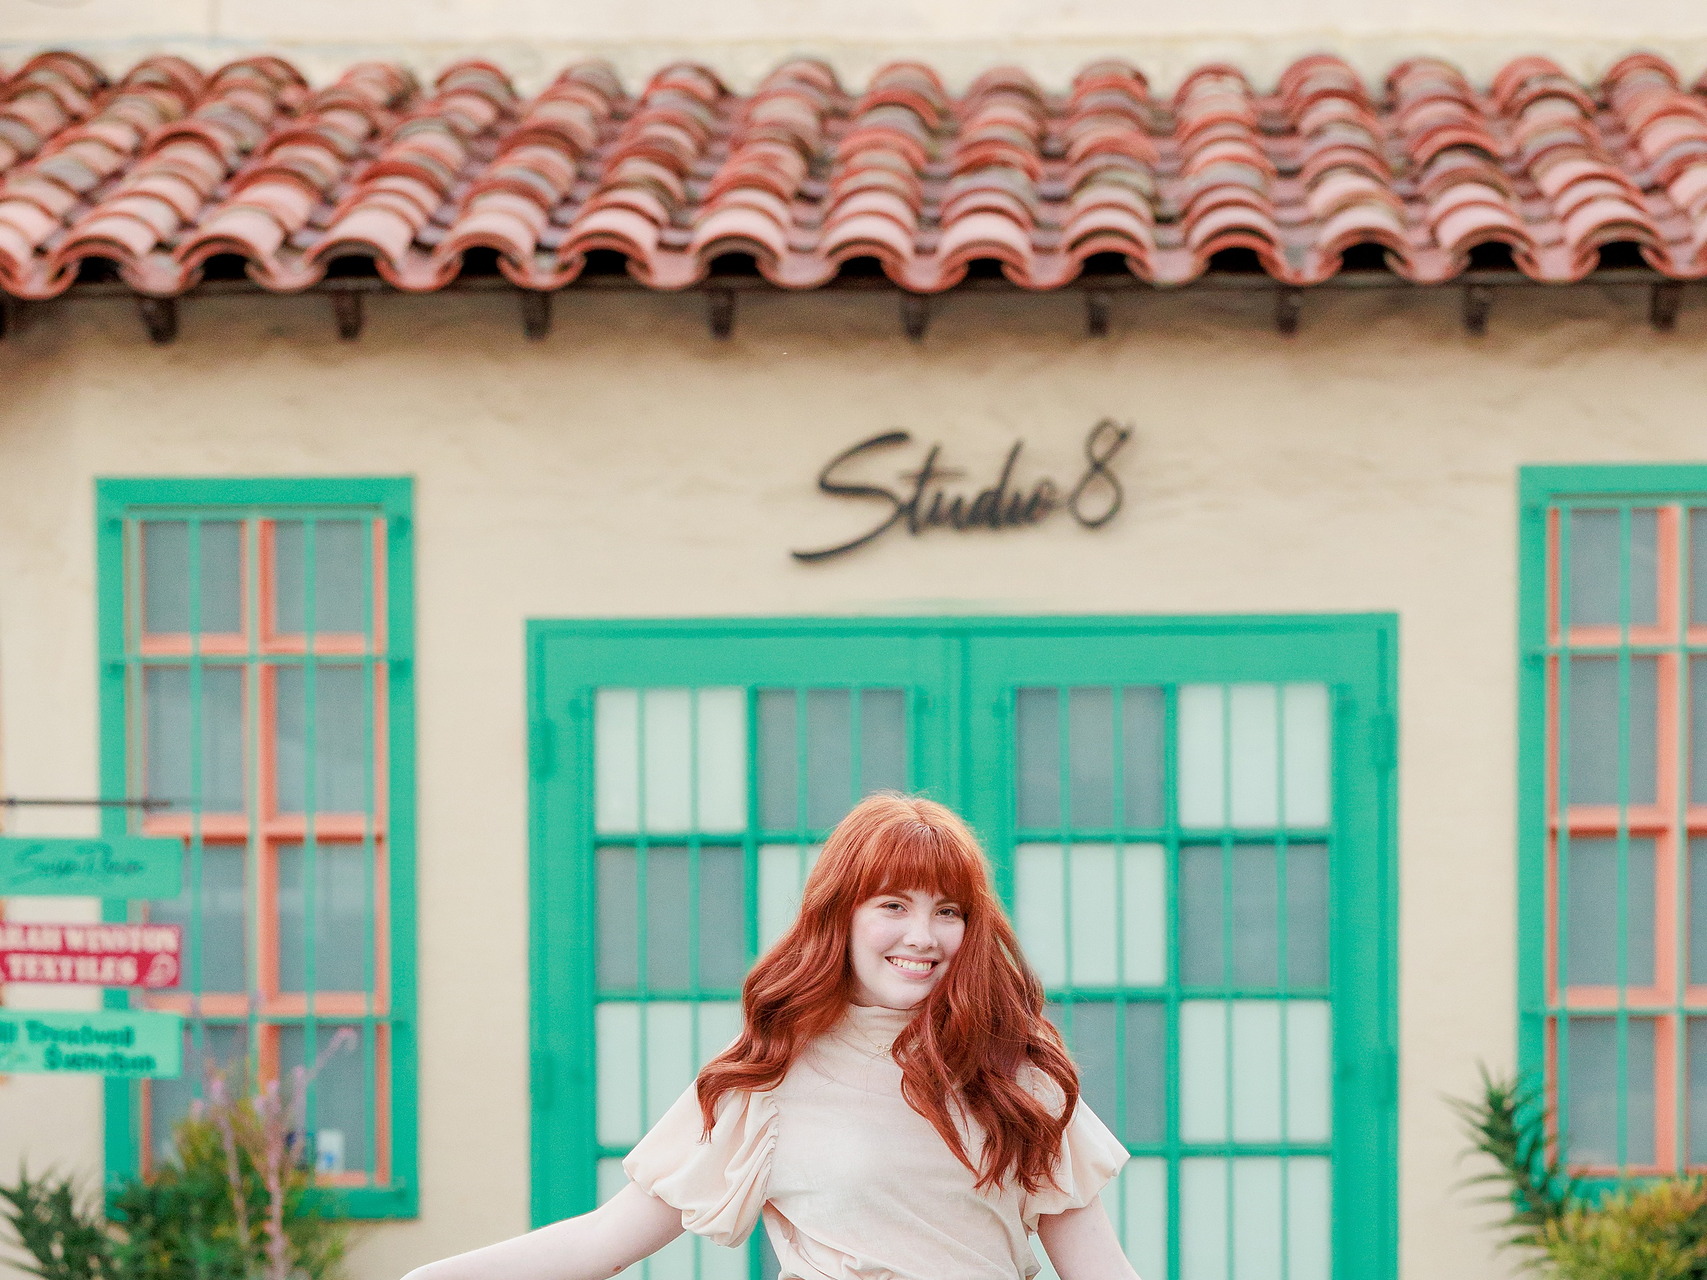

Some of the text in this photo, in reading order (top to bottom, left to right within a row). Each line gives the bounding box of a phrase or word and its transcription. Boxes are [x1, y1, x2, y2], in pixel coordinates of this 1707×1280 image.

[790, 417, 1134, 563] Studio 8
[4, 954, 138, 982] TEXTILES
